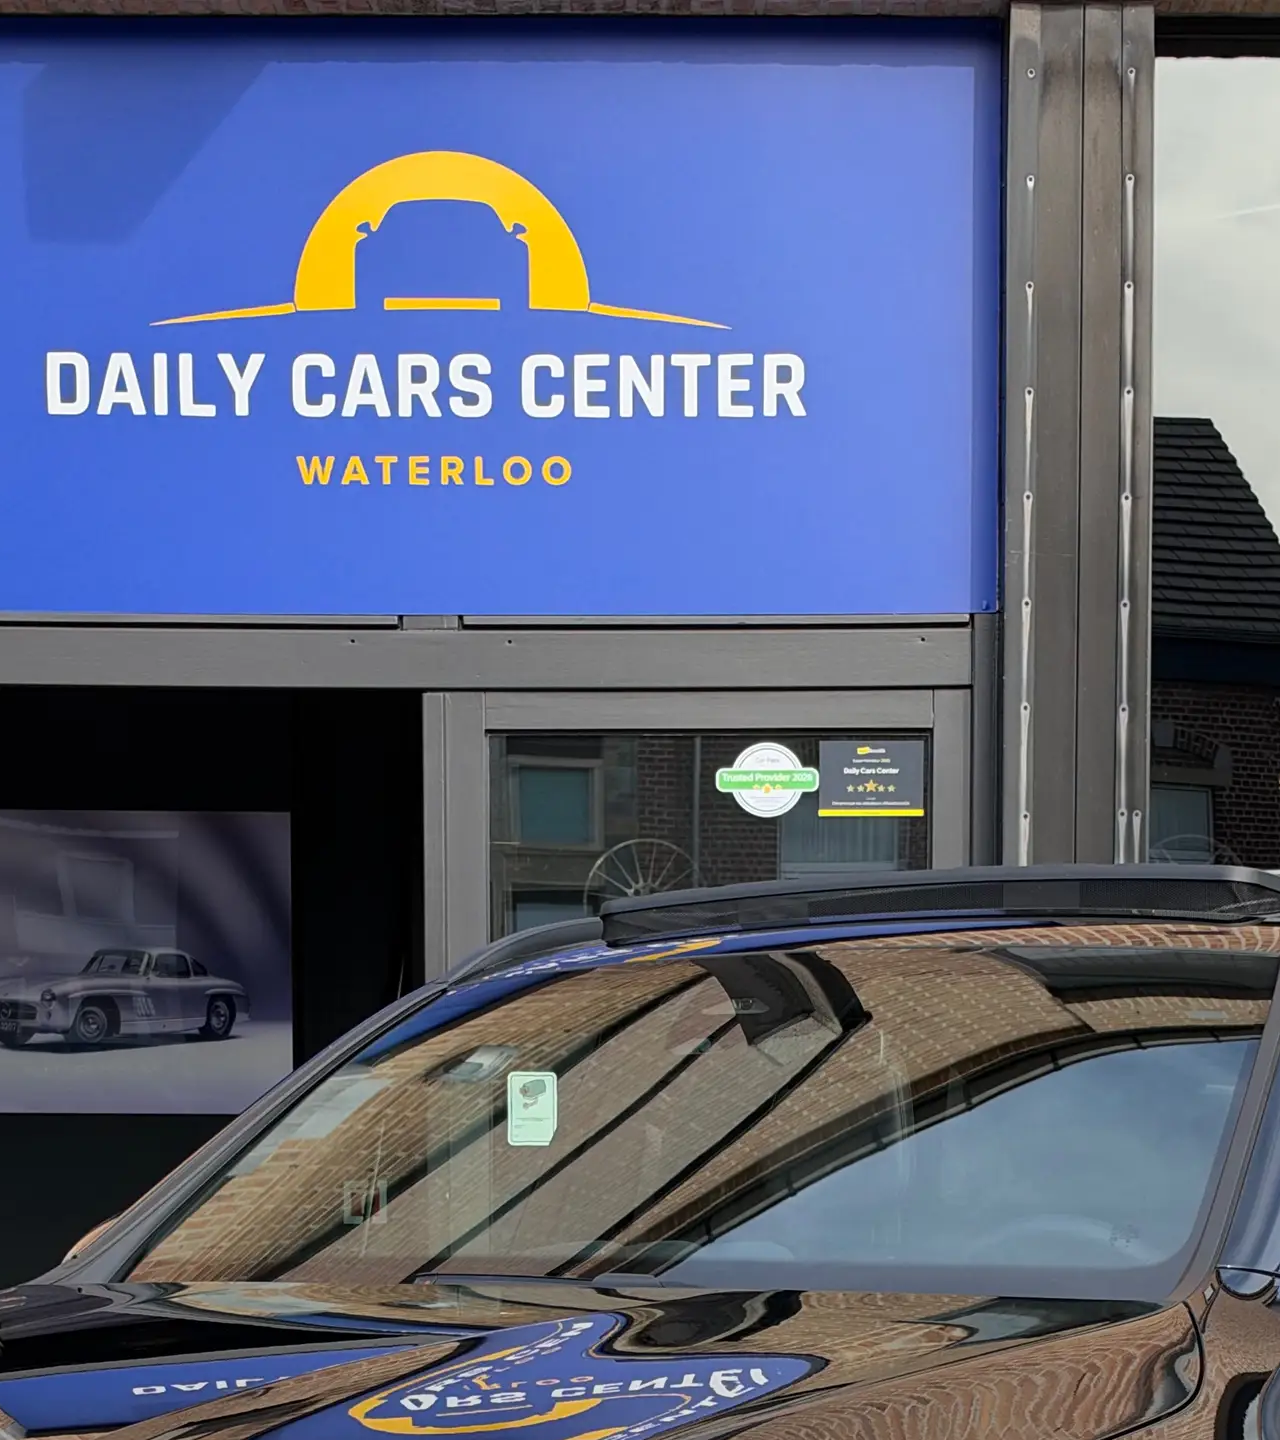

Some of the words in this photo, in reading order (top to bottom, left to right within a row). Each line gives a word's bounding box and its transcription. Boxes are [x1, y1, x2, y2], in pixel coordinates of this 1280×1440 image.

[46, 351, 265, 417] DAILY
[292, 353, 493, 418] CARS
[521, 353, 808, 419] CENTER
[297, 455, 574, 487] WATERLOO
[721, 772, 753, 782] Trusted
[755, 772, 790, 782] Provider
[843, 767, 859, 775] Daily
